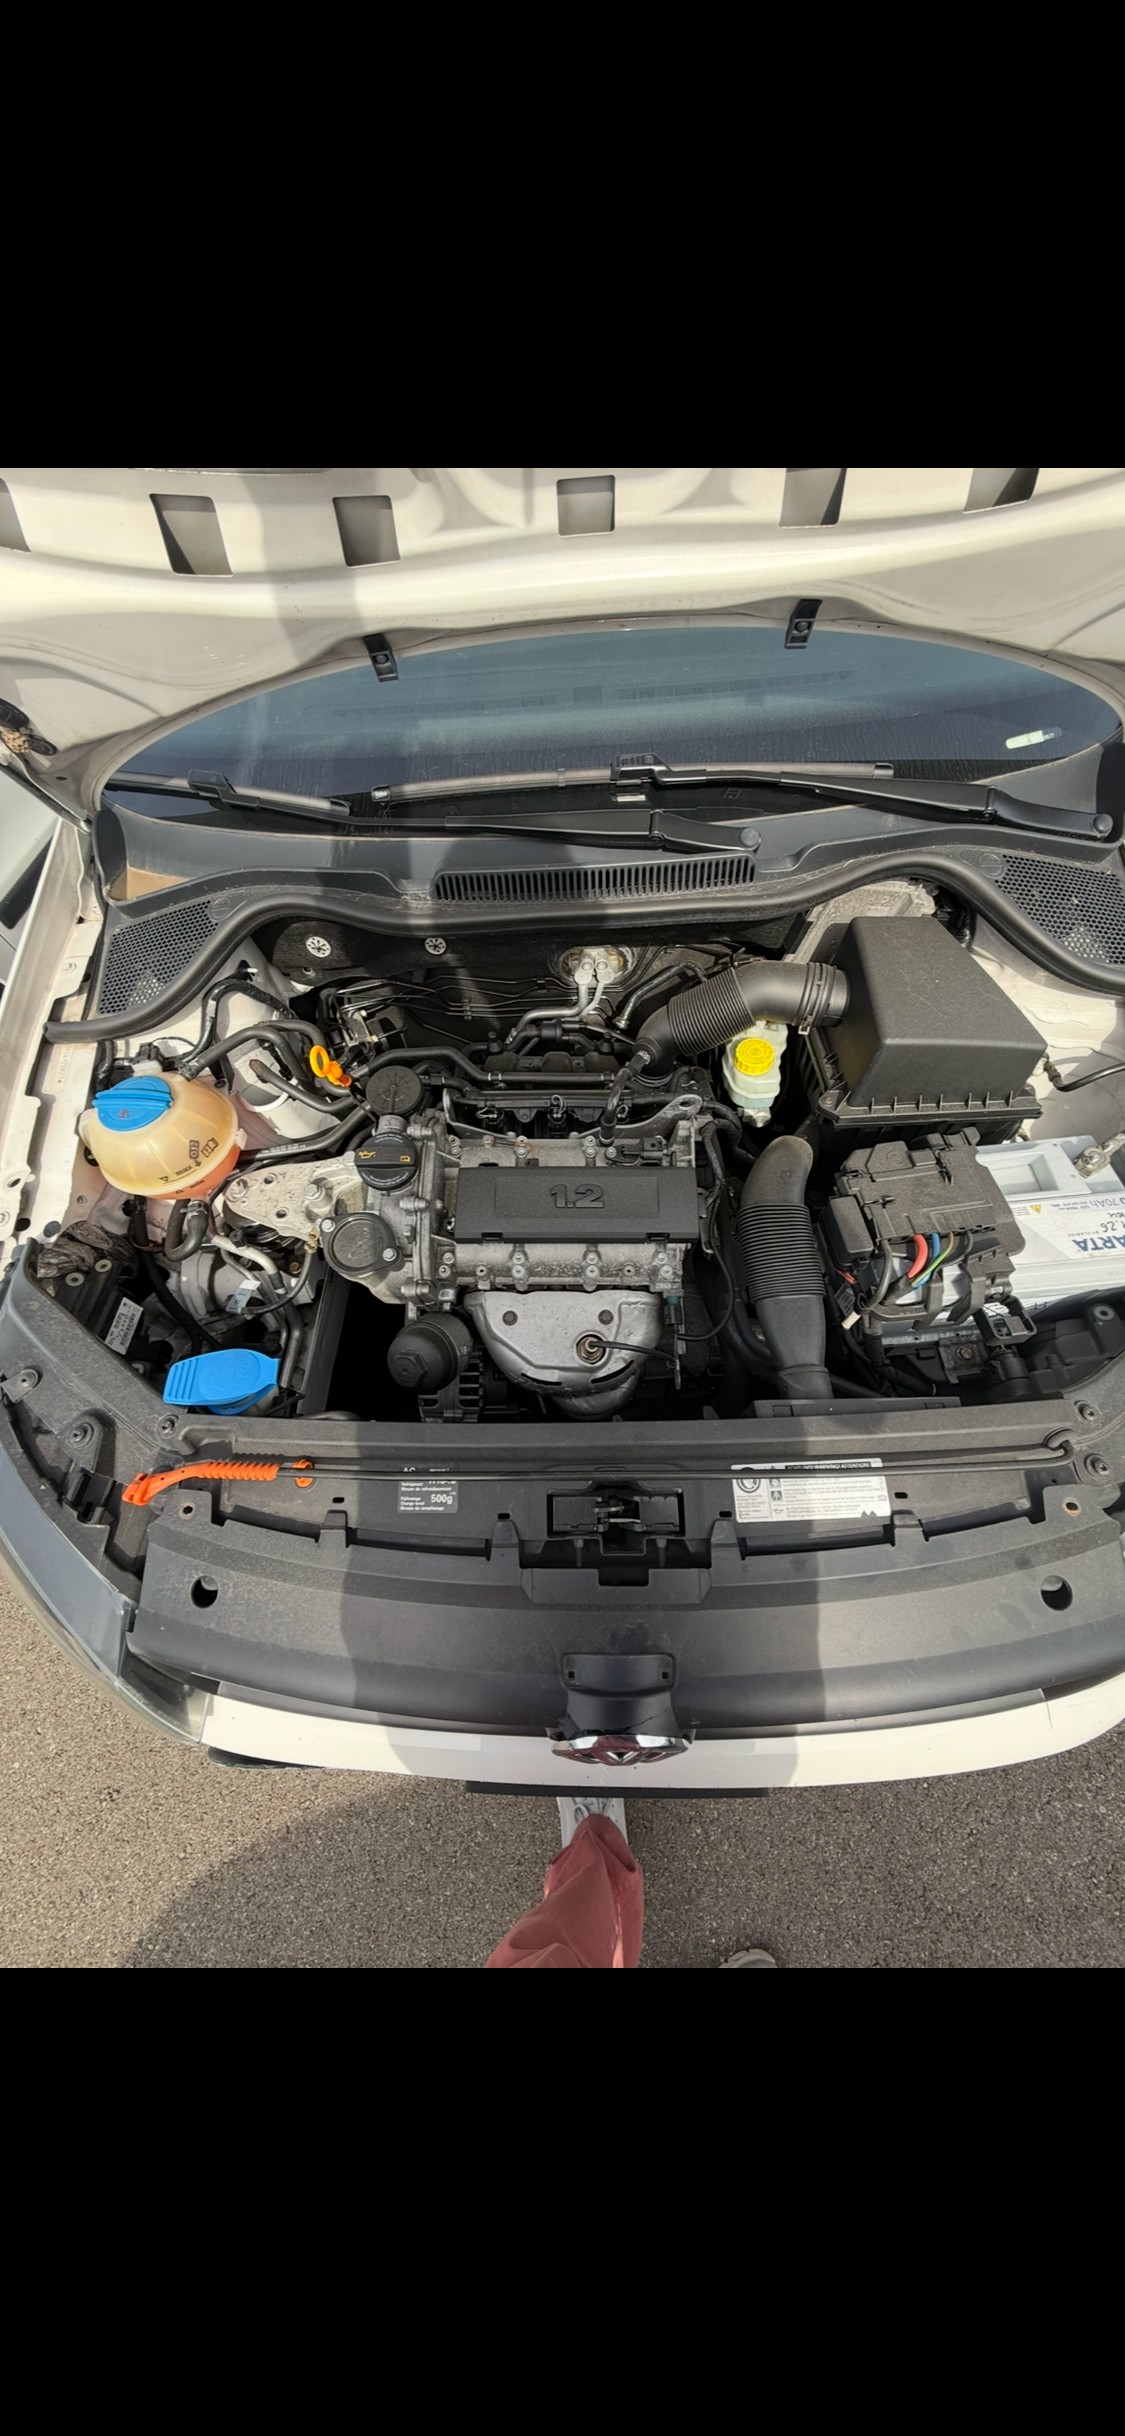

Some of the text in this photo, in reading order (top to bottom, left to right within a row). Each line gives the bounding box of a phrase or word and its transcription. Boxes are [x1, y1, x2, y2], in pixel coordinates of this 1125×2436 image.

[175, 1165, 193, 1176] max
[550, 1184, 605, 1209] 1.2
[1089, 1198, 1119, 1208] 70Ah
[431, 1494, 453, 1505] 500g
